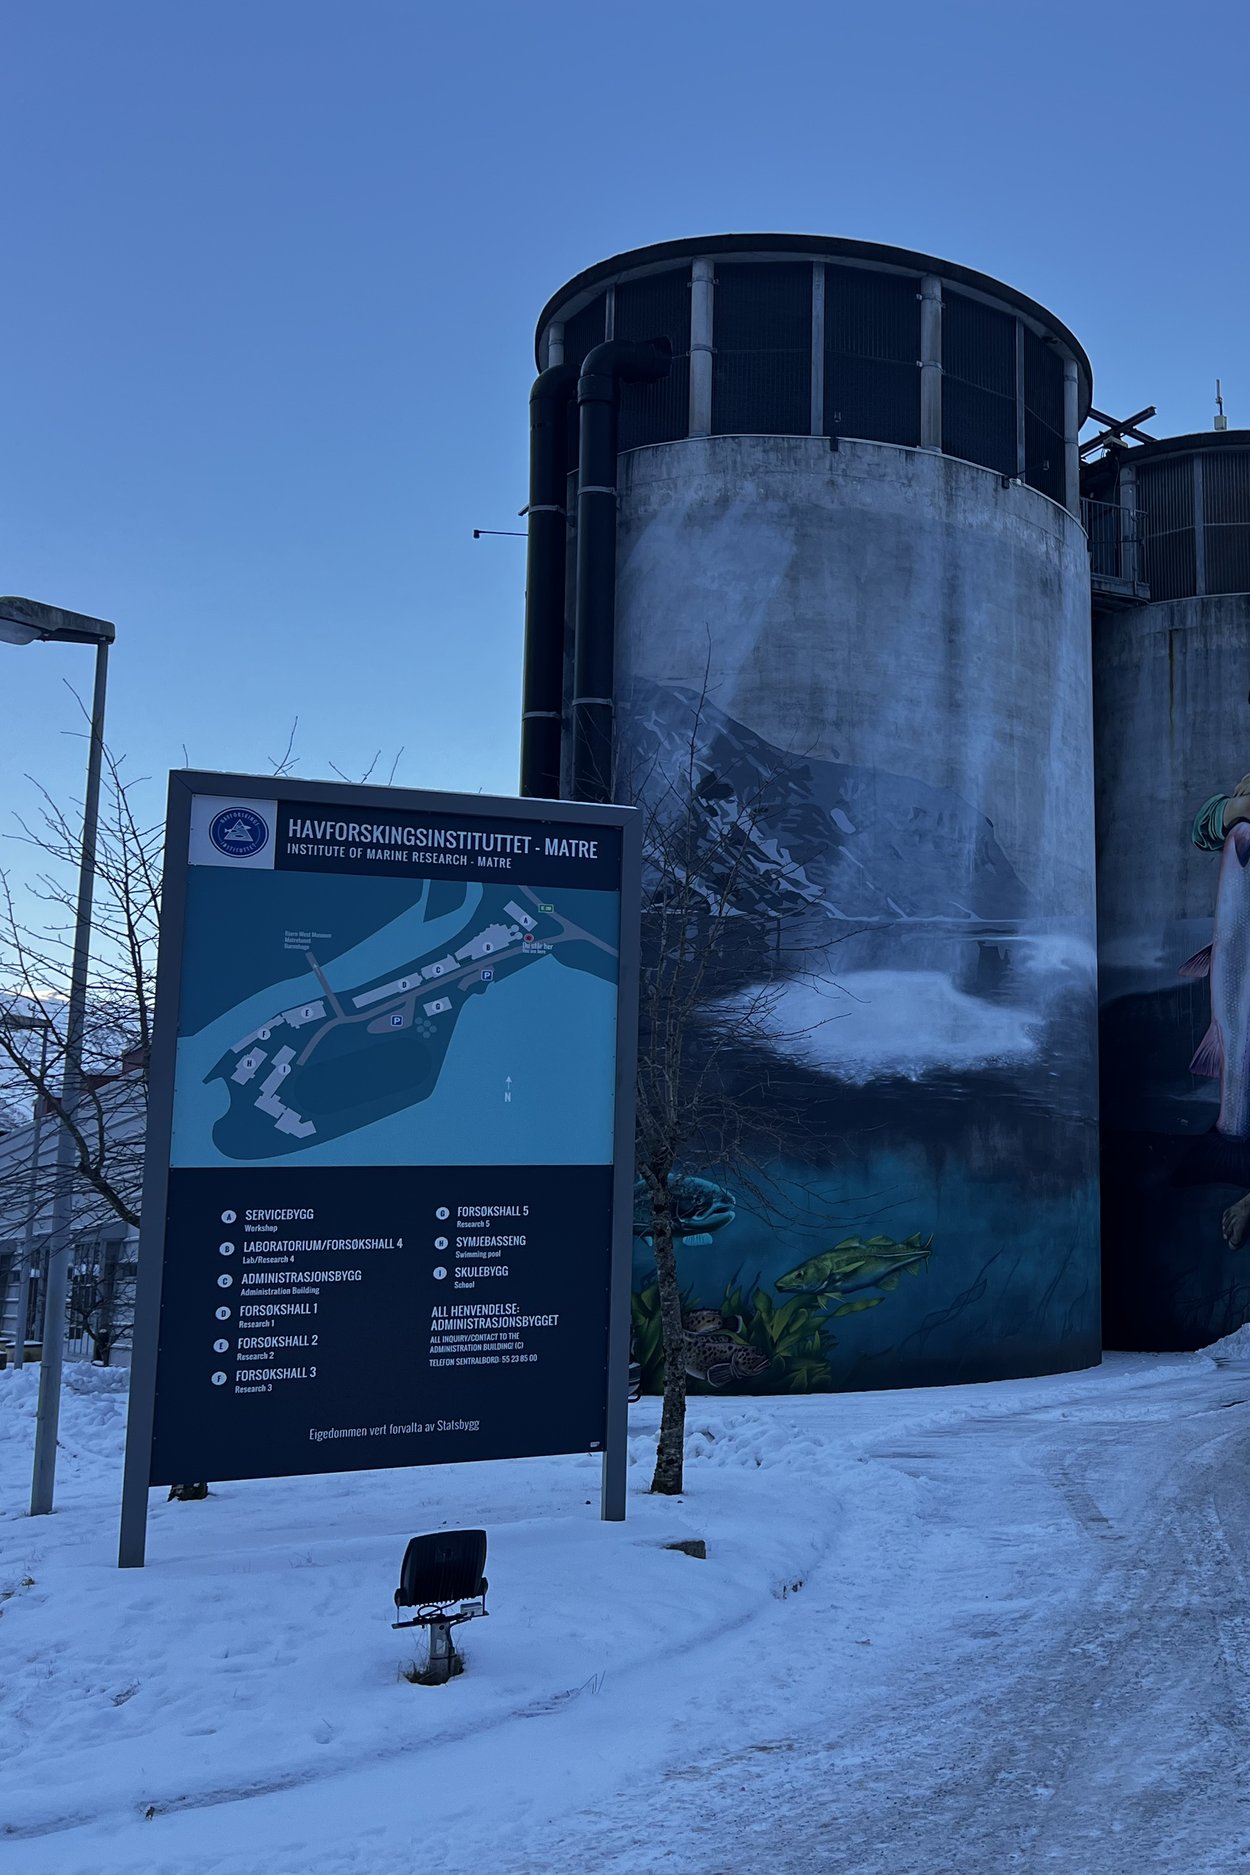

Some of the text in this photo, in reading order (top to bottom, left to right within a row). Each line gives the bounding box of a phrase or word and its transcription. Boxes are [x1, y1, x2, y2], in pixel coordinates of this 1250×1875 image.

[288, 819, 532, 853] HAVFORSKINGSINSTITUTTET
[544, 838, 598, 859] MATRE
[287, 843, 346, 858] INSTITUTE
[349, 847, 363, 859] OF
[366, 848, 409, 862] MARINE
[412, 851, 467, 866] RESEARCH
[477, 856, 512, 869] MATRE
[436, 966, 441, 974] C
[402, 981, 407, 989] D
[305, 1009, 310, 1017] E
[262, 1030, 267, 1038] F
[505, 1092, 511, 1102] N
[226, 1208, 314, 1221] A SERVICEBYGG
[457, 1206, 521, 1217] FORSØKSHALL
[523, 1205, 529, 1216] 5
[244, 1224, 278, 1233] Workshop
[456, 1220, 490, 1228] Research 5
[243, 1238, 395, 1253] LABORATORIUM/FORSØKSHALL
[396, 1238, 404, 1249] 4
[456, 1235, 527, 1247] SYMJEBASSENG
[242, 1255, 295, 1264] Lab/Research 4
[455, 1250, 502, 1259] Swimming pool
[222, 1270, 362, 1286] C ADMINISTRASJONSBYGG
[454, 1266, 509, 1278] SKULEBYGG
[240, 1286, 320, 1296] Administration Building
[454, 1281, 475, 1289] School
[240, 1303, 311, 1317] FORSØKSHALL
[313, 1303, 318, 1314] 1
[431, 1303, 520, 1318] ALL HENVENDELSE:
[239, 1319, 275, 1329] Research 1
[430, 1314, 559, 1331] ADMINISTRASJONSBYGGET
[219, 1335, 319, 1350] E FORSØKSHALL 2
[430, 1332, 520, 1344] ALL INQUIRY/CONTACT TO THE
[429, 1343, 482, 1353] ADMINISTRATION
[514, 1341, 524, 1349] (C)
[237, 1352, 275, 1361] Research 2
[429, 1358, 455, 1367] TELEFON
[501, 1355, 510, 1363] 55
[511, 1355, 519, 1363] 23
[529, 1354, 538, 1362] 00
[217, 1366, 317, 1383] F FORSØKSHALL 3
[235, 1384, 273, 1394] Research 3
[309, 1418, 481, 1442] Eigedommen vert forvalta av Statsbygg
